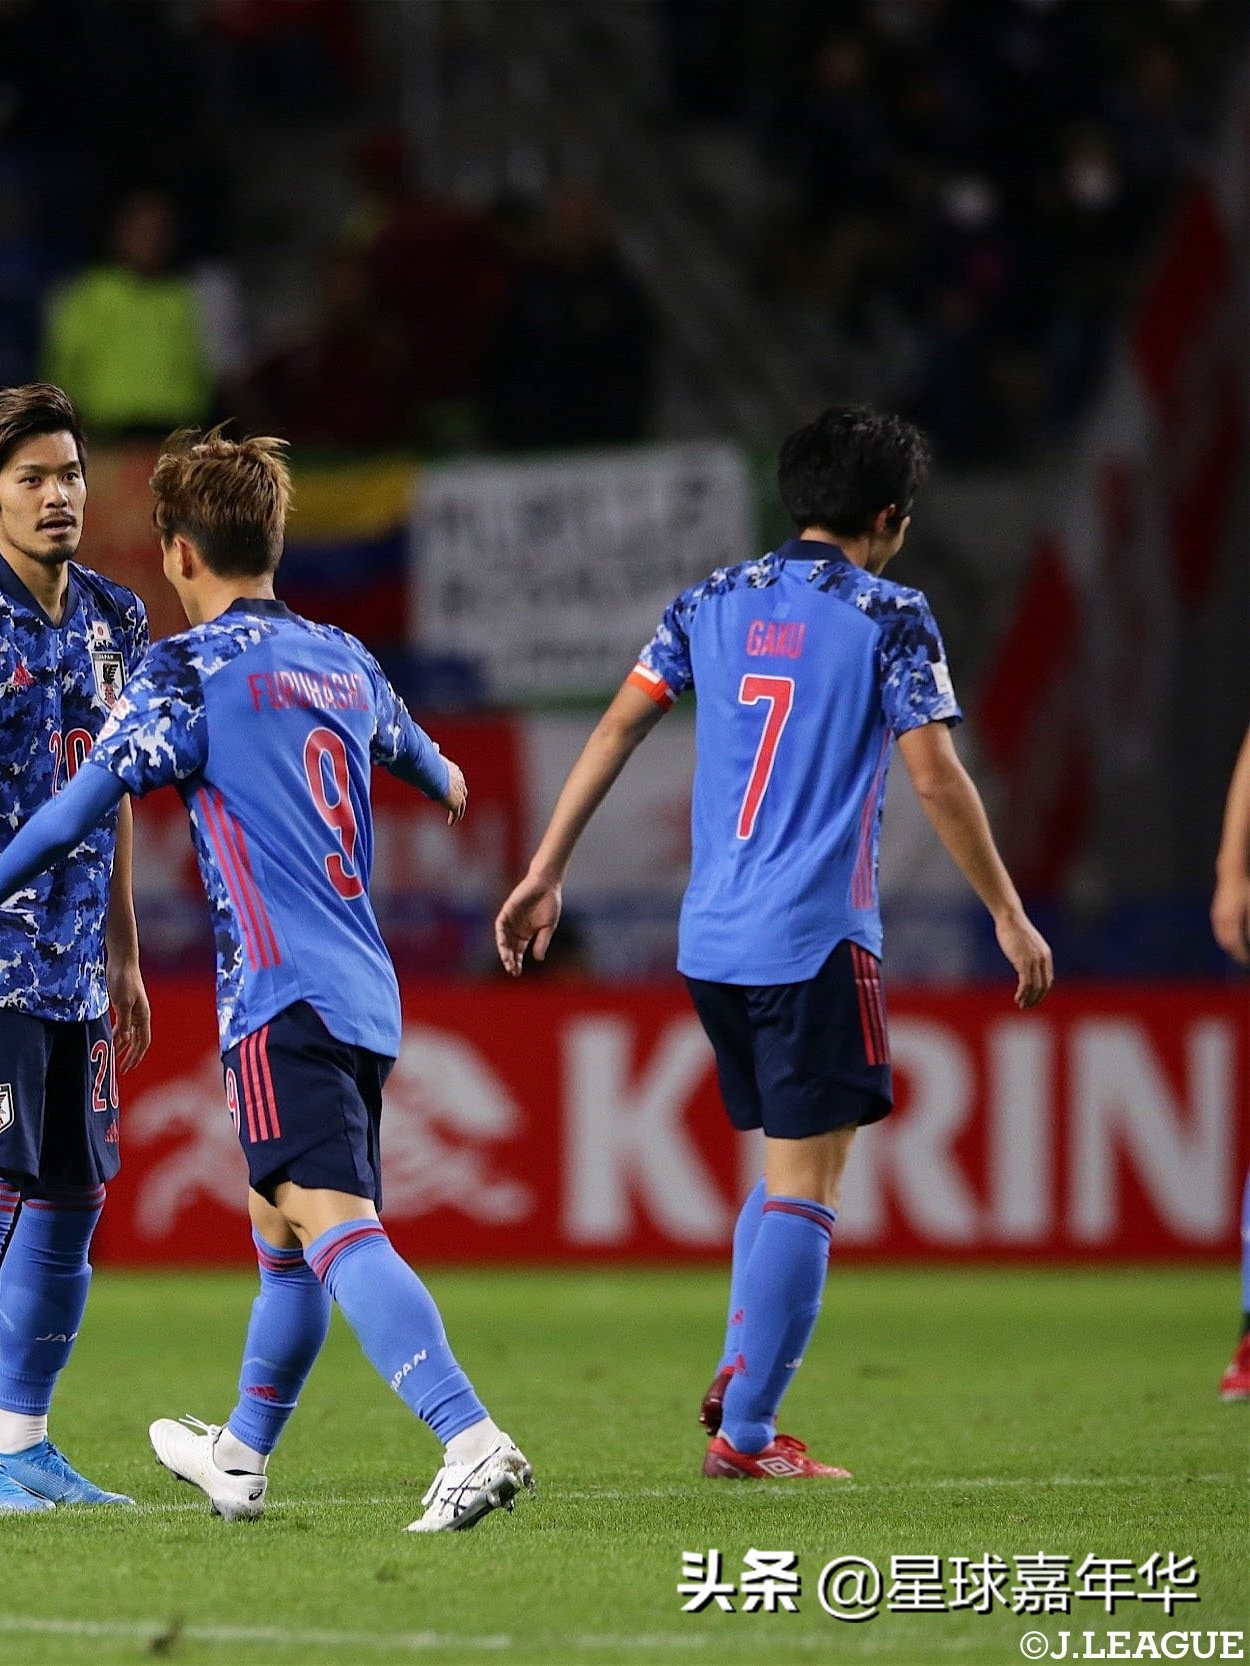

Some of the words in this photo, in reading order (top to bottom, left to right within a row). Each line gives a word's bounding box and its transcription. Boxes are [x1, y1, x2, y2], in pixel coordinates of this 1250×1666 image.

[248, 671, 369, 712] FURUHASHI
[747, 620, 806, 659] GAKU
[736, 673, 795, 840] 7
[304, 726, 365, 900] 9
[558, 1014, 1238, 1247] KRIN
[390, 1348, 427, 1392] APAN
